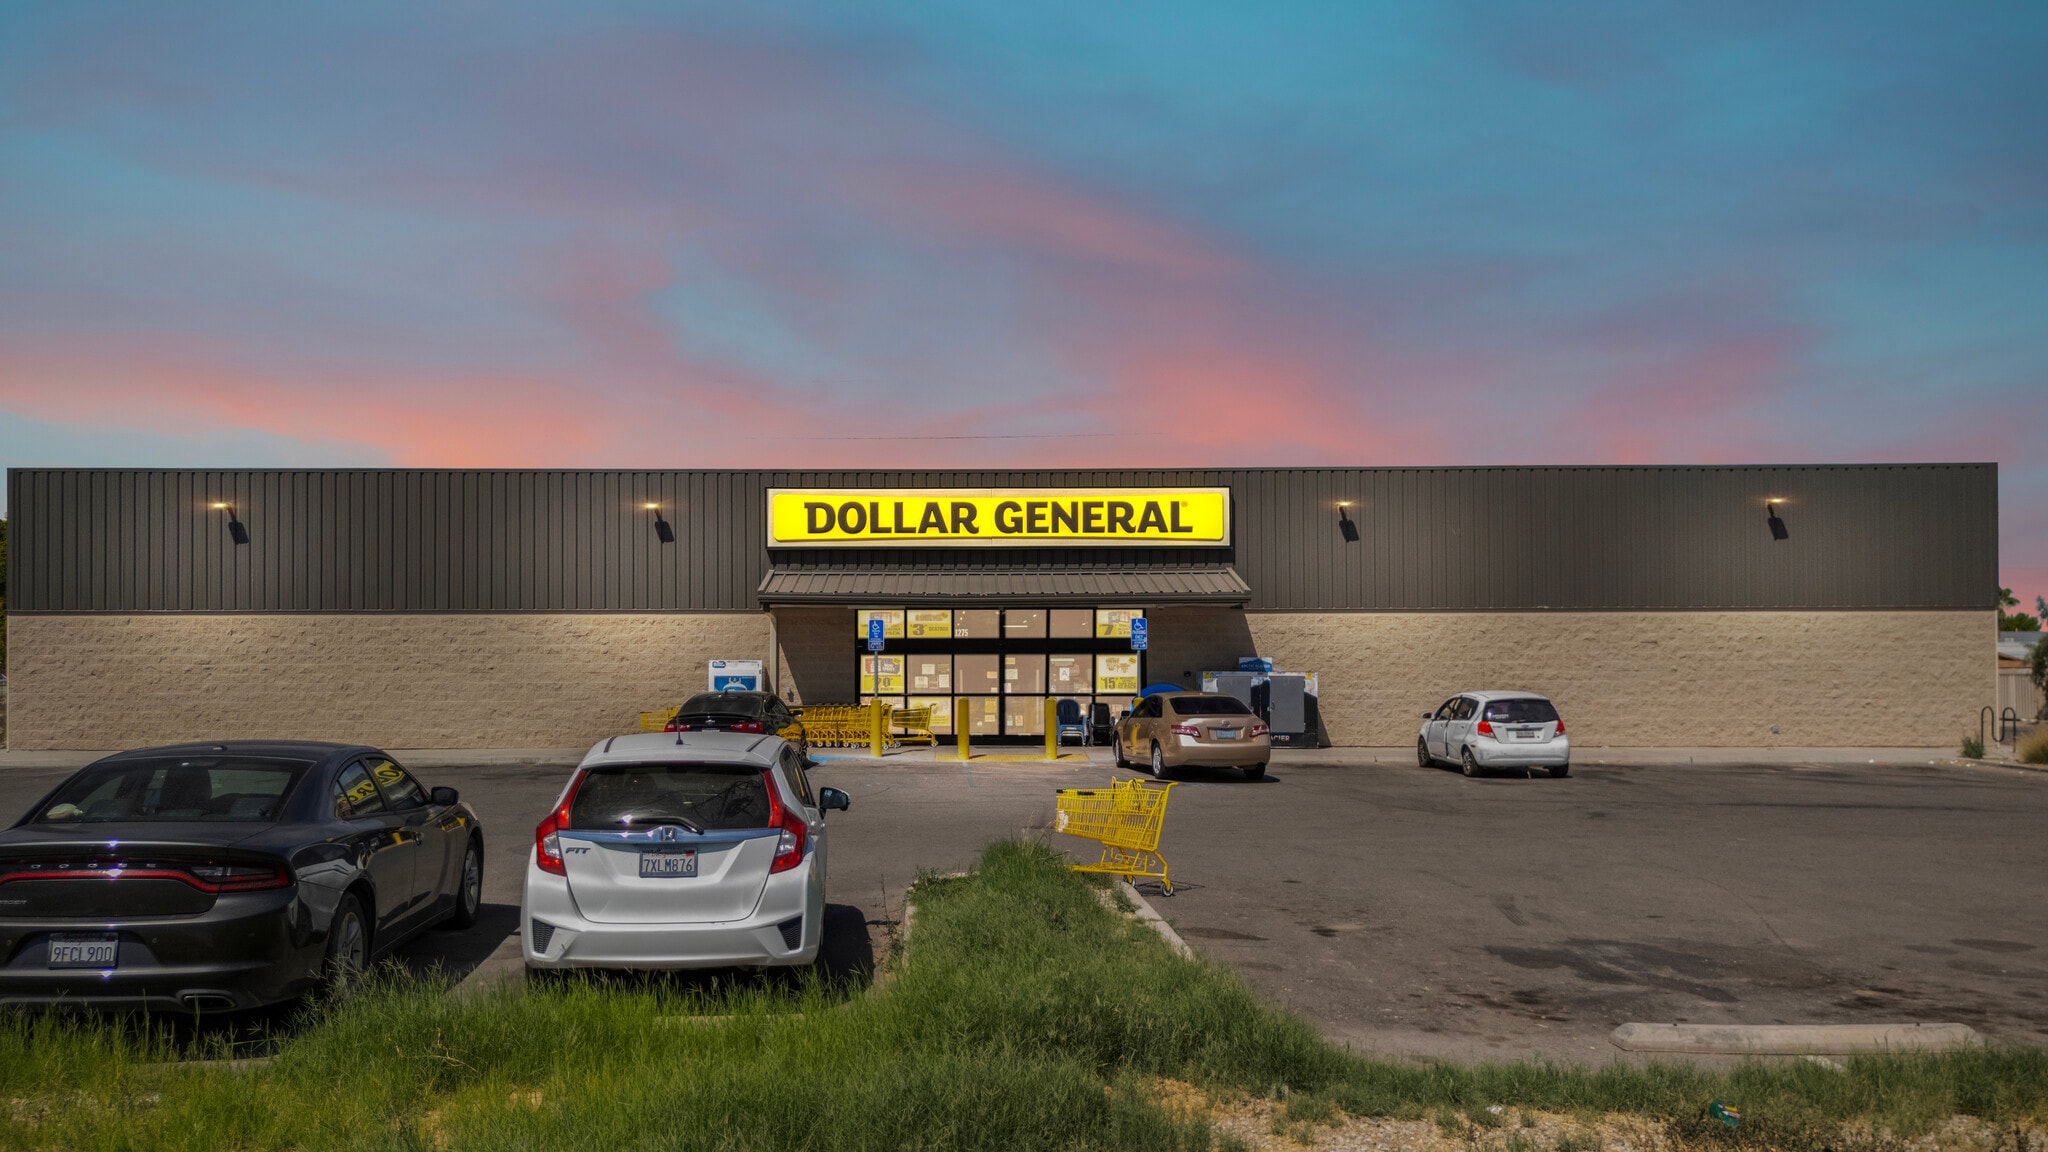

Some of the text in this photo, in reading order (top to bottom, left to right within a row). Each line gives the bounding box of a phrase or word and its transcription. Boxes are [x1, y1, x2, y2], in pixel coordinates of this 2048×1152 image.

[804, 501, 1193, 535] DOLLAR GENERAL
[955, 629, 969, 637] 1275
[643, 858, 693, 873] 7XLM876
[53, 946, 112, 962] 9FCL900
